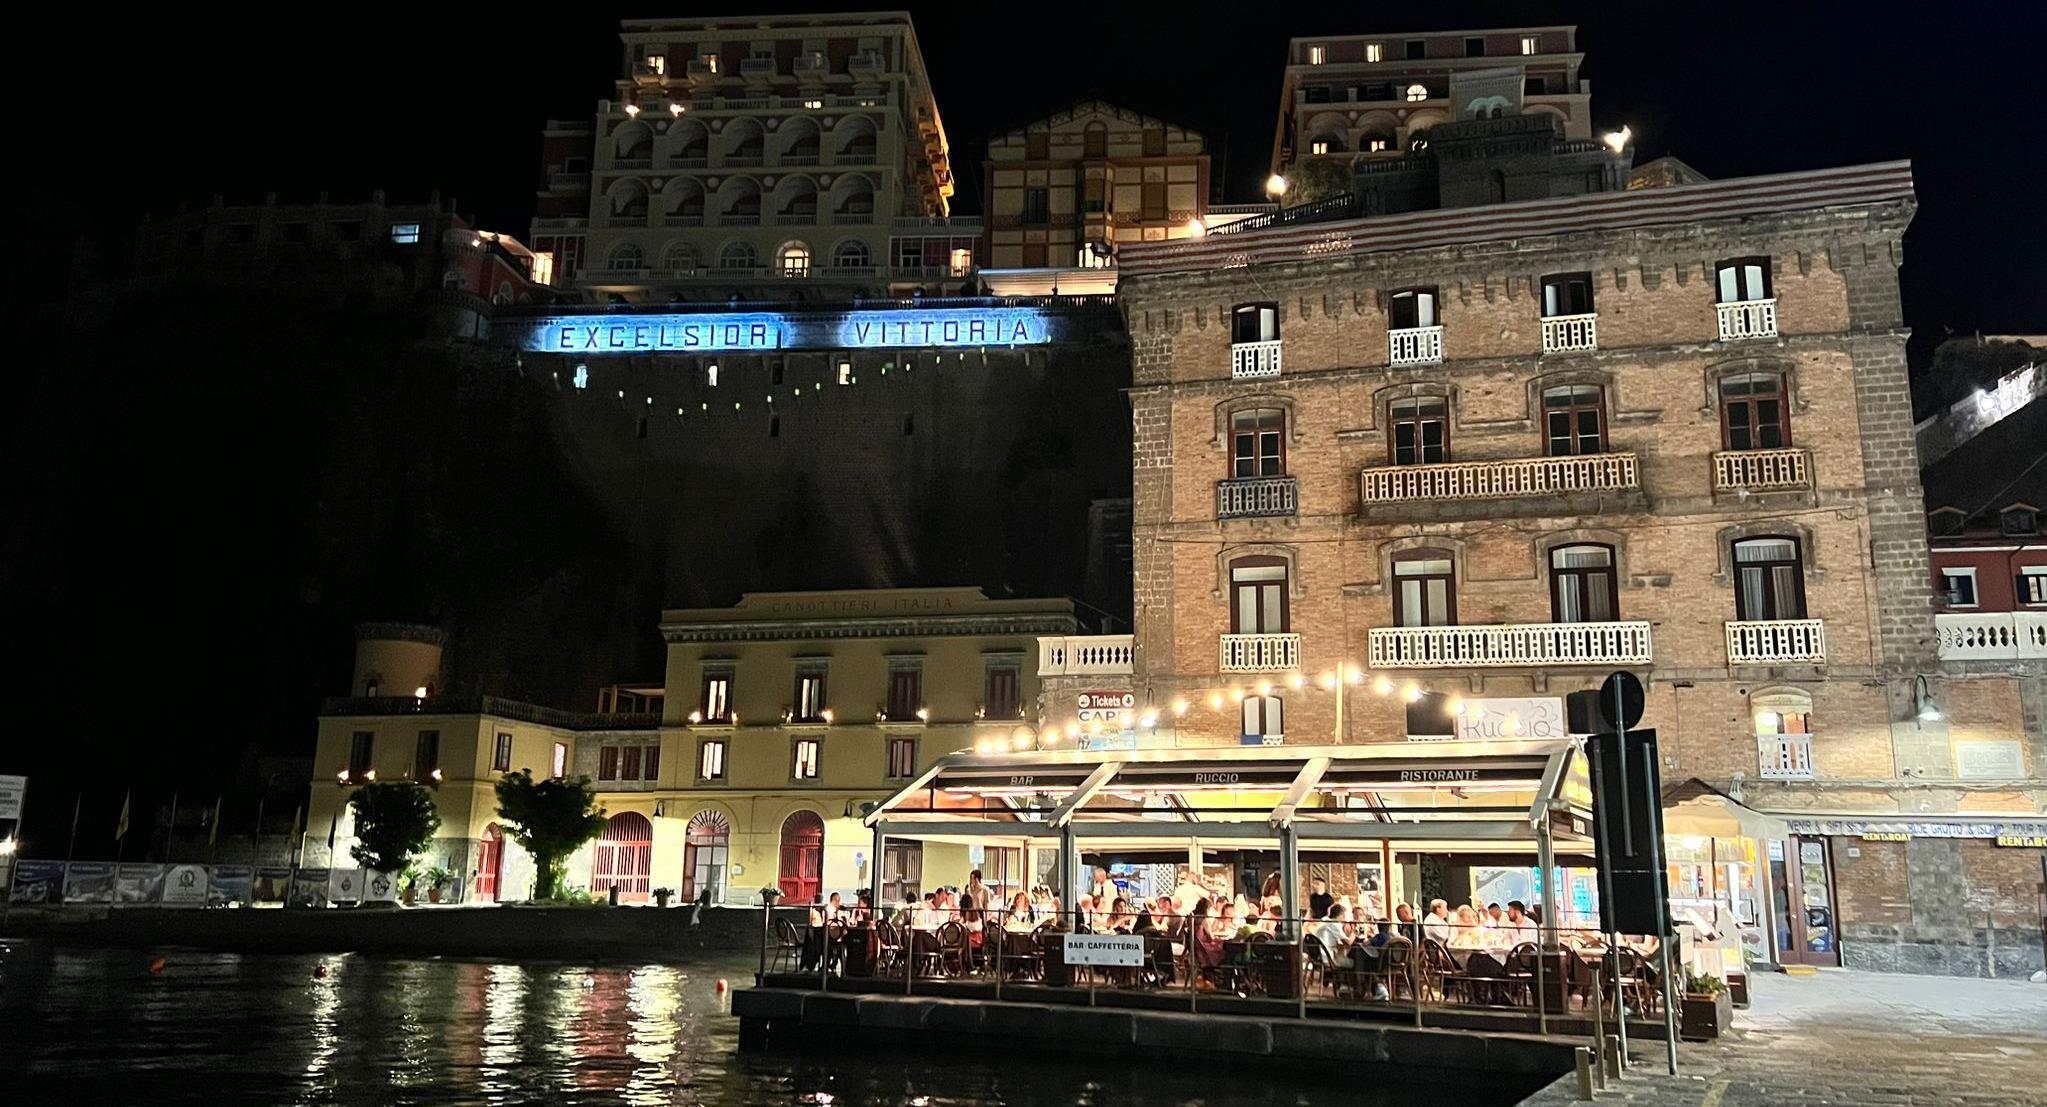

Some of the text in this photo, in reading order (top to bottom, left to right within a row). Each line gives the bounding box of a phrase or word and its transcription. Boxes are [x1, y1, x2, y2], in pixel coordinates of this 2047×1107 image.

[561, 319, 1029, 349] EXCELSIOR VITTORIA
[772, 598, 952, 612] CANOTTIERI ITALIA
[1091, 695, 1121, 707] Tickets
[1010, 770, 1479, 786] BAR RUCCIO RISTORANTE
[1087, 942, 1140, 950] CAFFETTERIA
